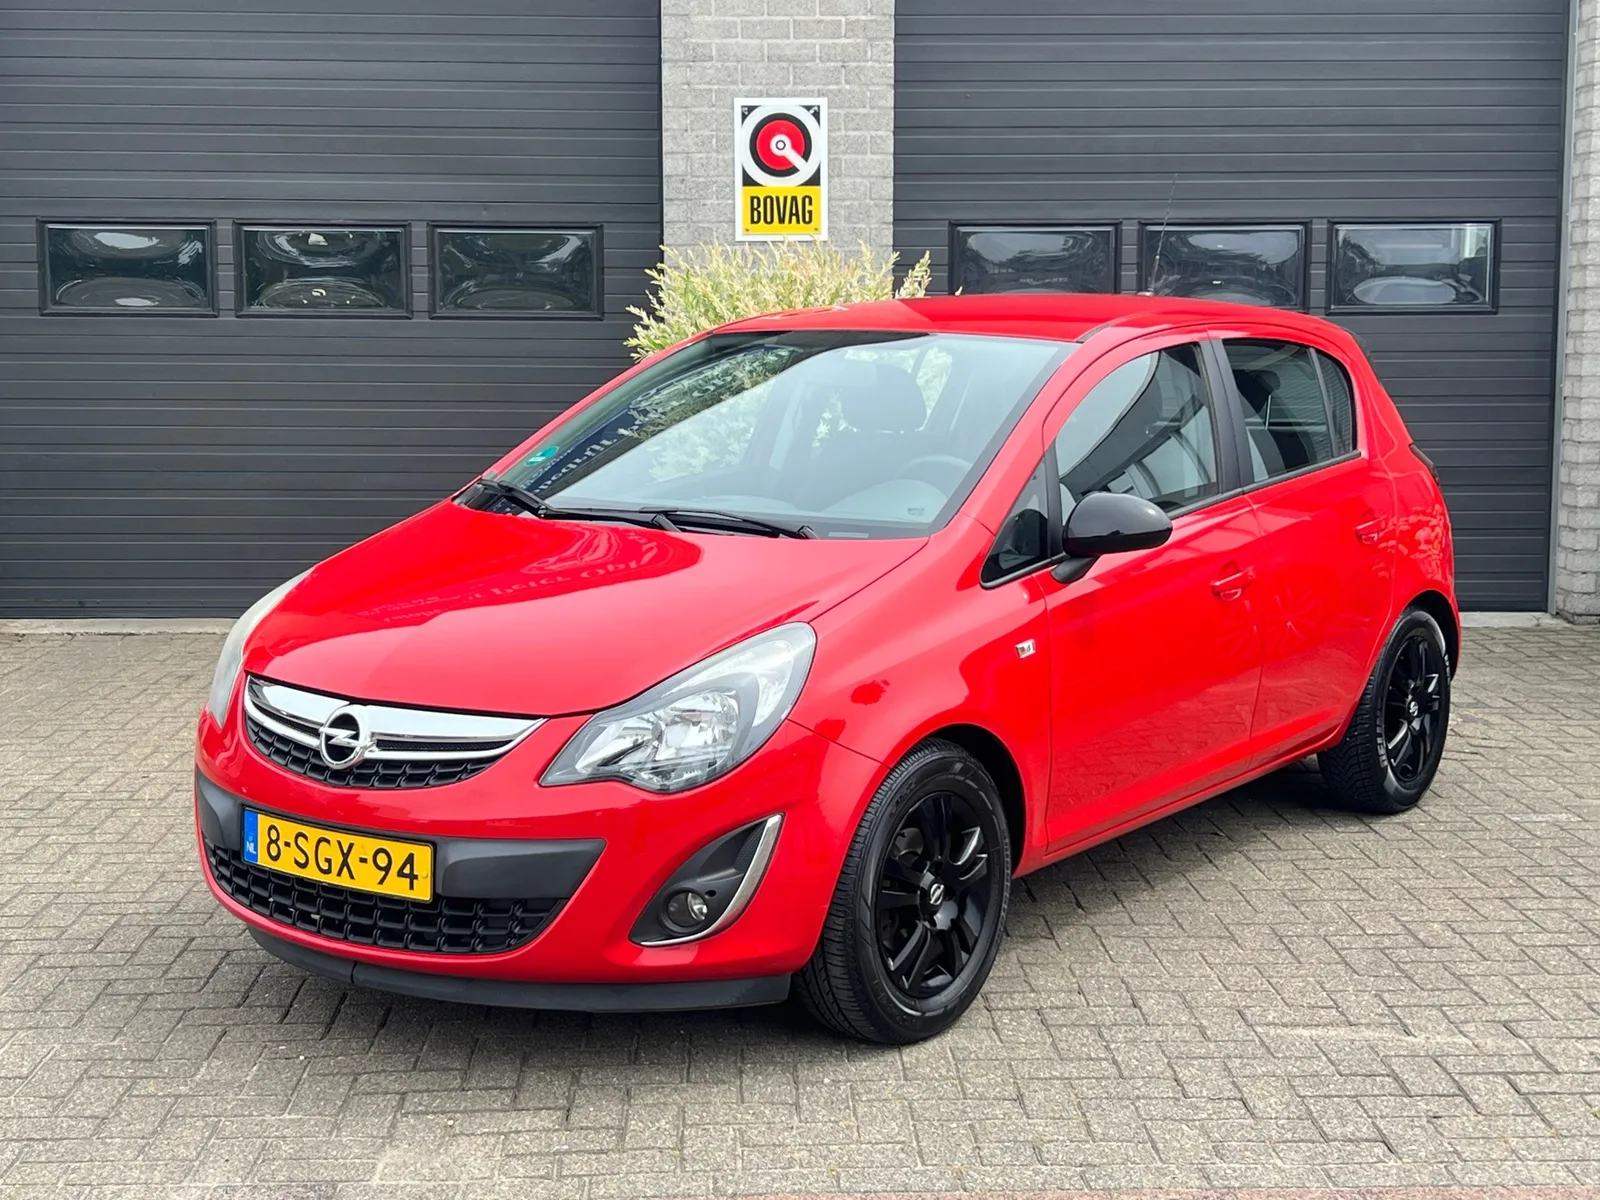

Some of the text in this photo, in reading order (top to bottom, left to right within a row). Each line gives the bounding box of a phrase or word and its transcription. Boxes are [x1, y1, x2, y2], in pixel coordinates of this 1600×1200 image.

[750, 195, 813, 225] BOVAG
[246, 840, 257, 854] NL
[266, 823, 419, 891] 8-SGX-94
